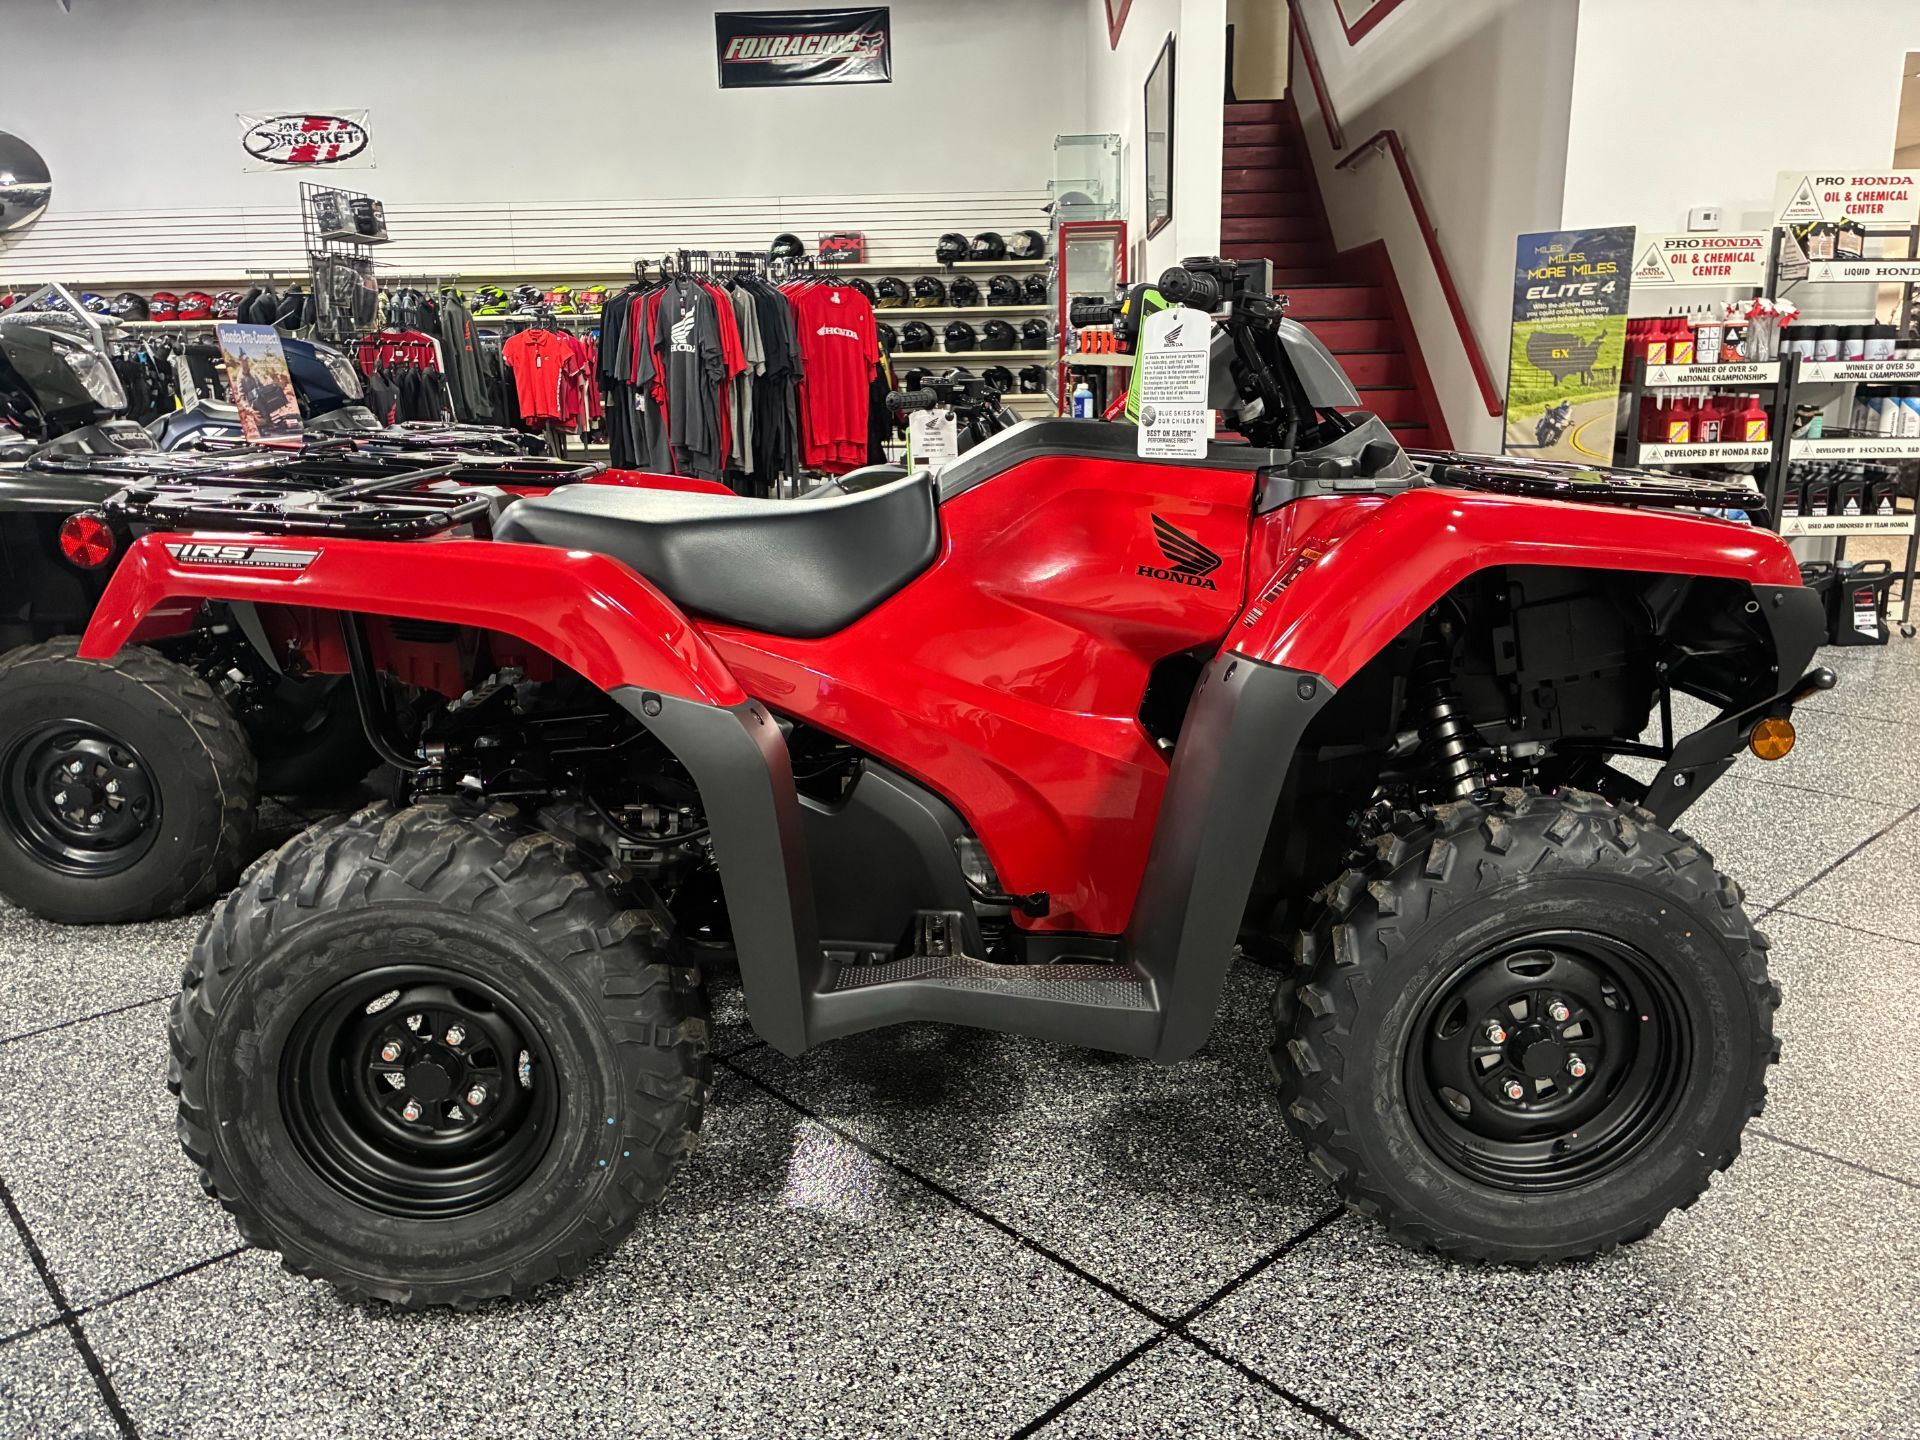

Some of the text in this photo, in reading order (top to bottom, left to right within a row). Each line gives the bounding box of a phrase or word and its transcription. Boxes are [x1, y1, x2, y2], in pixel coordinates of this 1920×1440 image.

[278, 122, 299, 132] JOE
[281, 131, 356, 146] ROCKET
[1816, 176, 1914, 186] PRO HONDA
[1824, 190, 1908, 202] OIL & CHEMICAL
[1845, 204, 1884, 214] CENTER
[1664, 238, 1763, 248] PRO HONDA
[1671, 252, 1756, 264] OIL & CHEMICAL
[1527, 266, 1567, 280] MORE
[1692, 265, 1731, 276] CENTER
[1844, 268, 1870, 277] LIQUID
[1526, 281, 1616, 299] ELITE 4
[1585, 306, 1609, 314] country
[1566, 322, 1581, 330] your
[220, 329, 242, 343] Honda
[824, 327, 859, 340] HONDA
[1552, 348, 1569, 359] 6X
[1689, 366, 1716, 374] WINNER
[1728, 365, 1747, 373] OVER
[1846, 363, 1873, 371] WINNER
[1886, 362, 1904, 370] OVER
[1906, 362, 1915, 370] 50
[1712, 373, 1767, 381] CHAMPIONSHIPS
[1664, 449, 1707, 457] DEVELOPED
[1722, 448, 1749, 456] HONDA
[1751, 447, 1769, 456] R&D
[180, 544, 249, 559] IRS
[1135, 564, 1218, 591] HONDA
